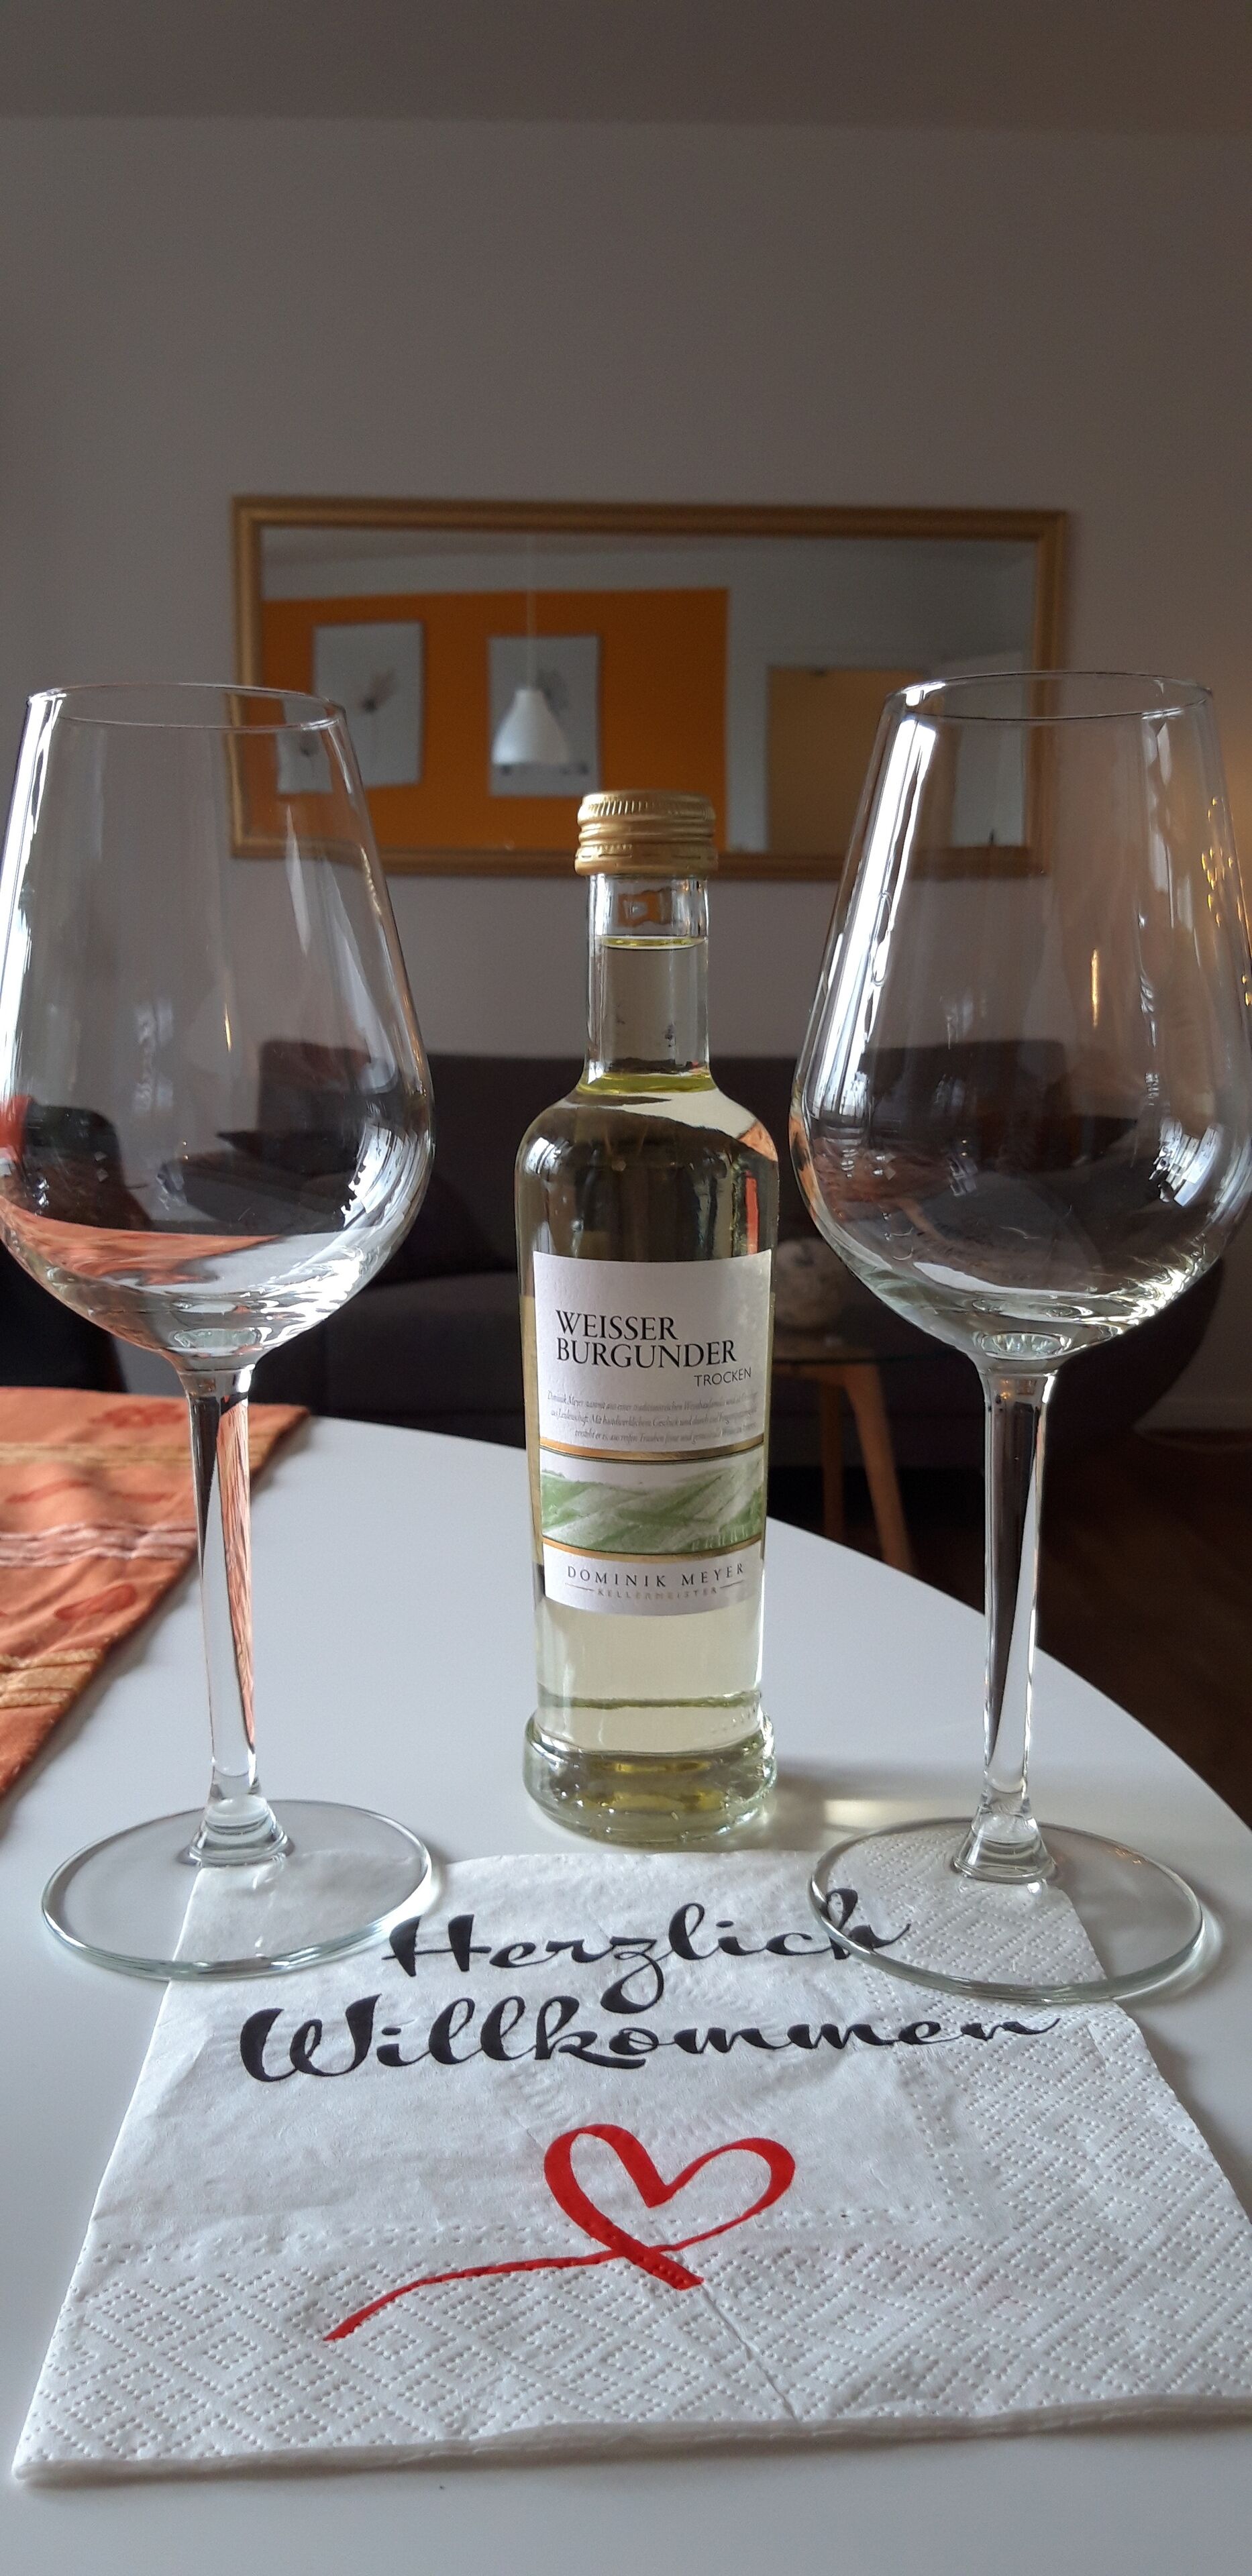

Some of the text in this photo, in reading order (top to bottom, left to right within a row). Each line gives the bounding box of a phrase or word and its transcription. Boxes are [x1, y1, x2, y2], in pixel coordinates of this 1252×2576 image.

[556, 1310, 678, 1340] WEISSER
[557, 1338, 737, 1368] BURGUNDER
[694, 1366, 751, 1387] TROCKEN
[567, 1562, 745, 1588] DOMINIK MEYER
[382, 1887, 911, 2015] Herzlich
[240, 1994, 1061, 2083] Willkommen
